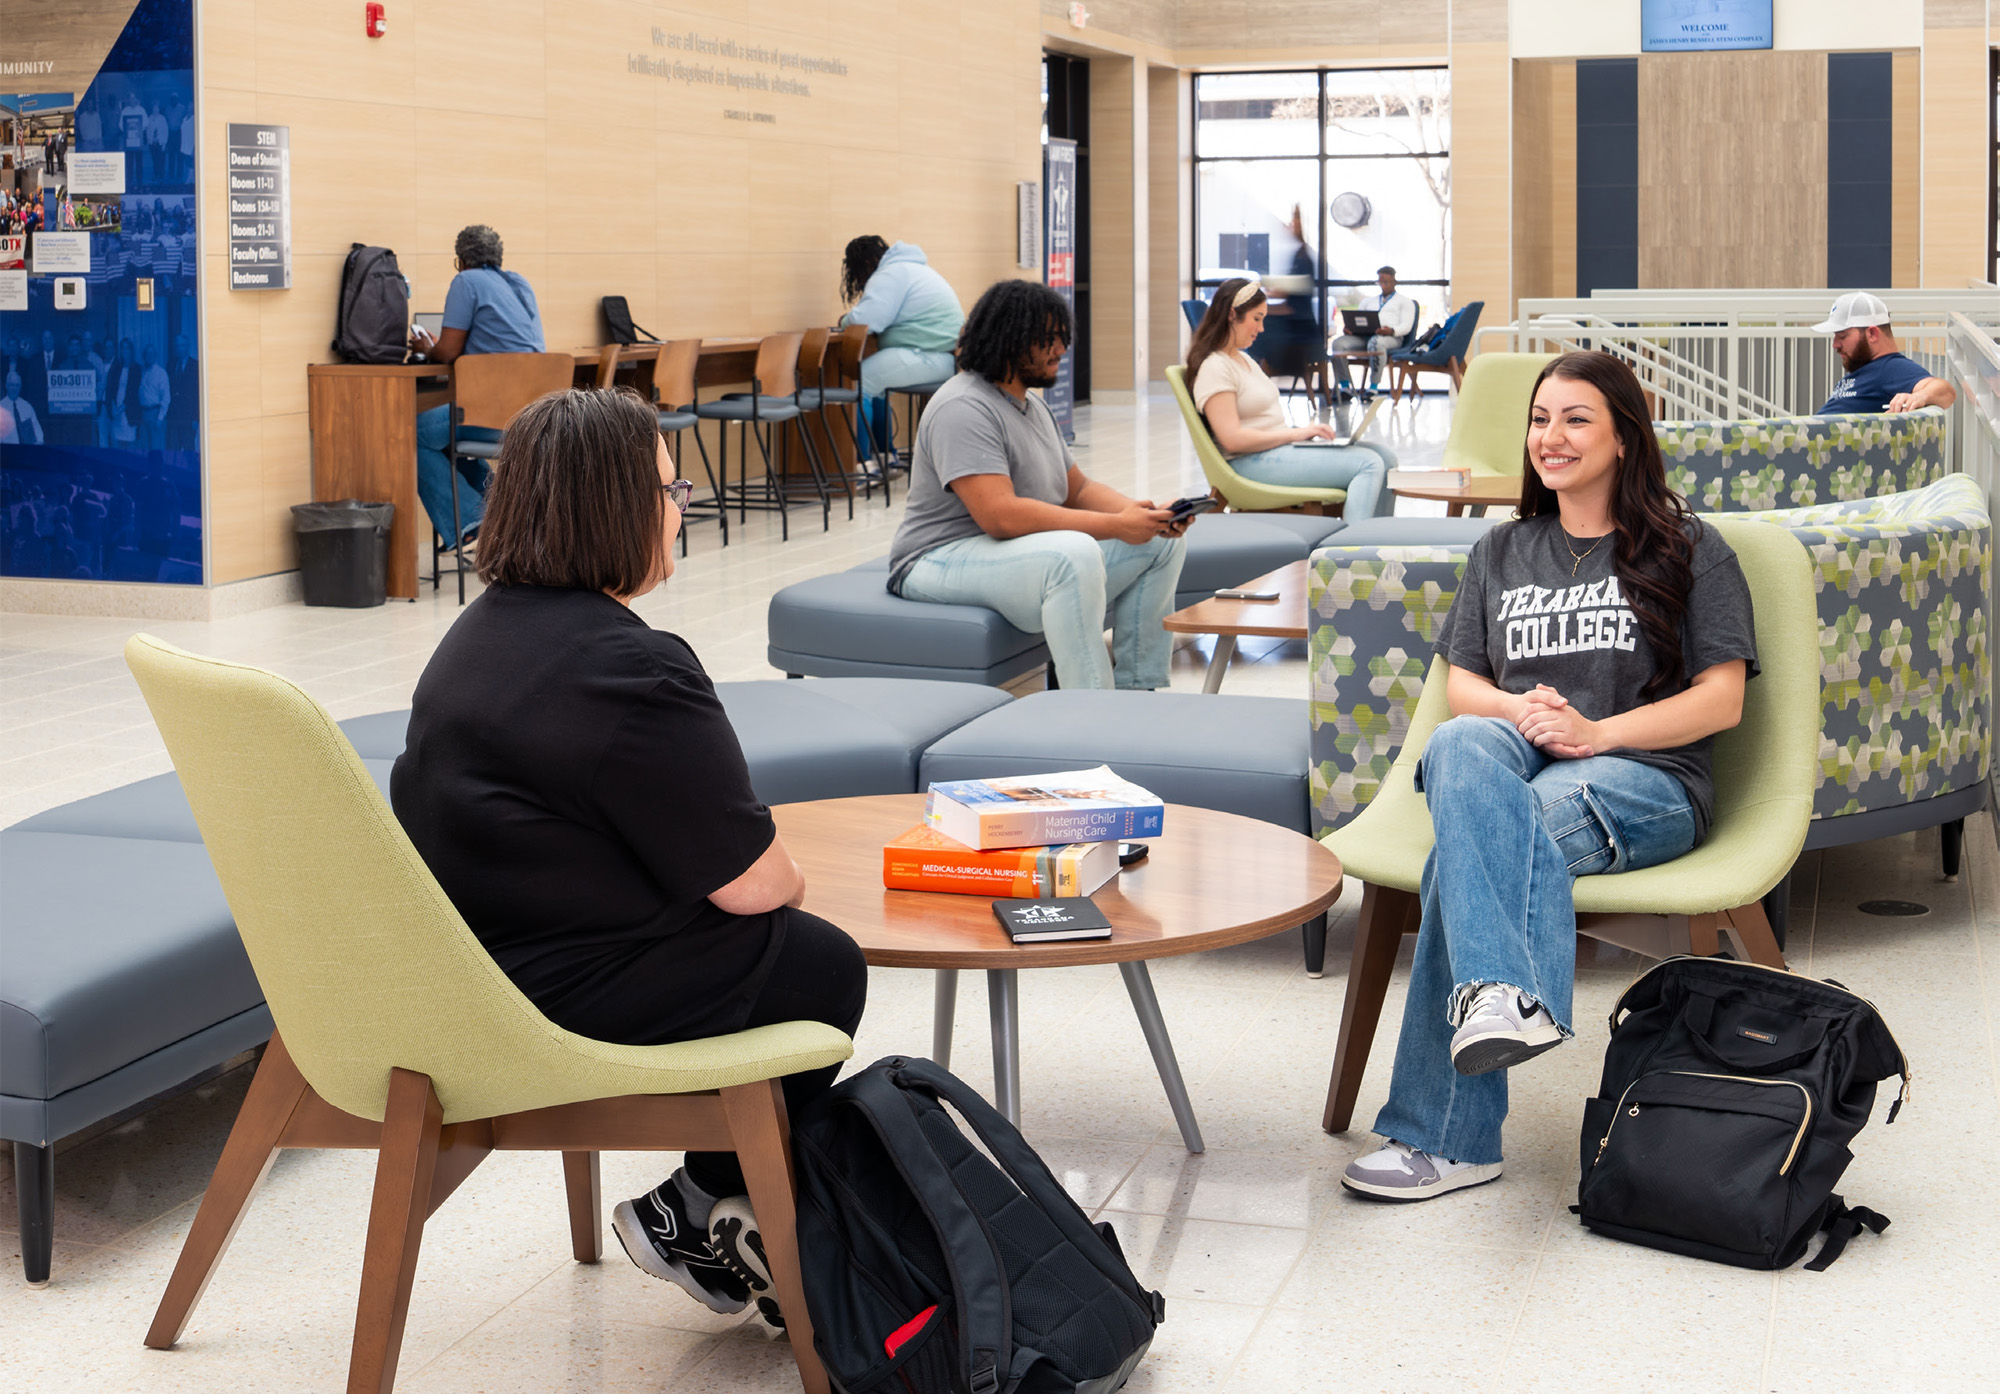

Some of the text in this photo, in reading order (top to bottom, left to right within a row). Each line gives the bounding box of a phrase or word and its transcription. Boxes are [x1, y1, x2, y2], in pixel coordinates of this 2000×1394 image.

[1681, 24, 1728, 32] WELCOME
[257, 130, 277, 146] STEM
[231, 152, 251, 166] Dean
[251, 152, 260, 166] of
[231, 176, 256, 189] Rooms
[231, 199, 257, 213] Rooms
[232, 223, 257, 237] Rooms
[0, 238, 22, 252] 0TX
[233, 246, 258, 263] Faculty
[233, 270, 269, 285] Restrooms
[1506, 609, 1638, 661] COLLEGE
[1045, 813, 1116, 828] Maternal Child
[1045, 825, 1107, 840] Nursing Care
[922, 864, 1028, 878] MEDICAL-SURGICAL NURSING
